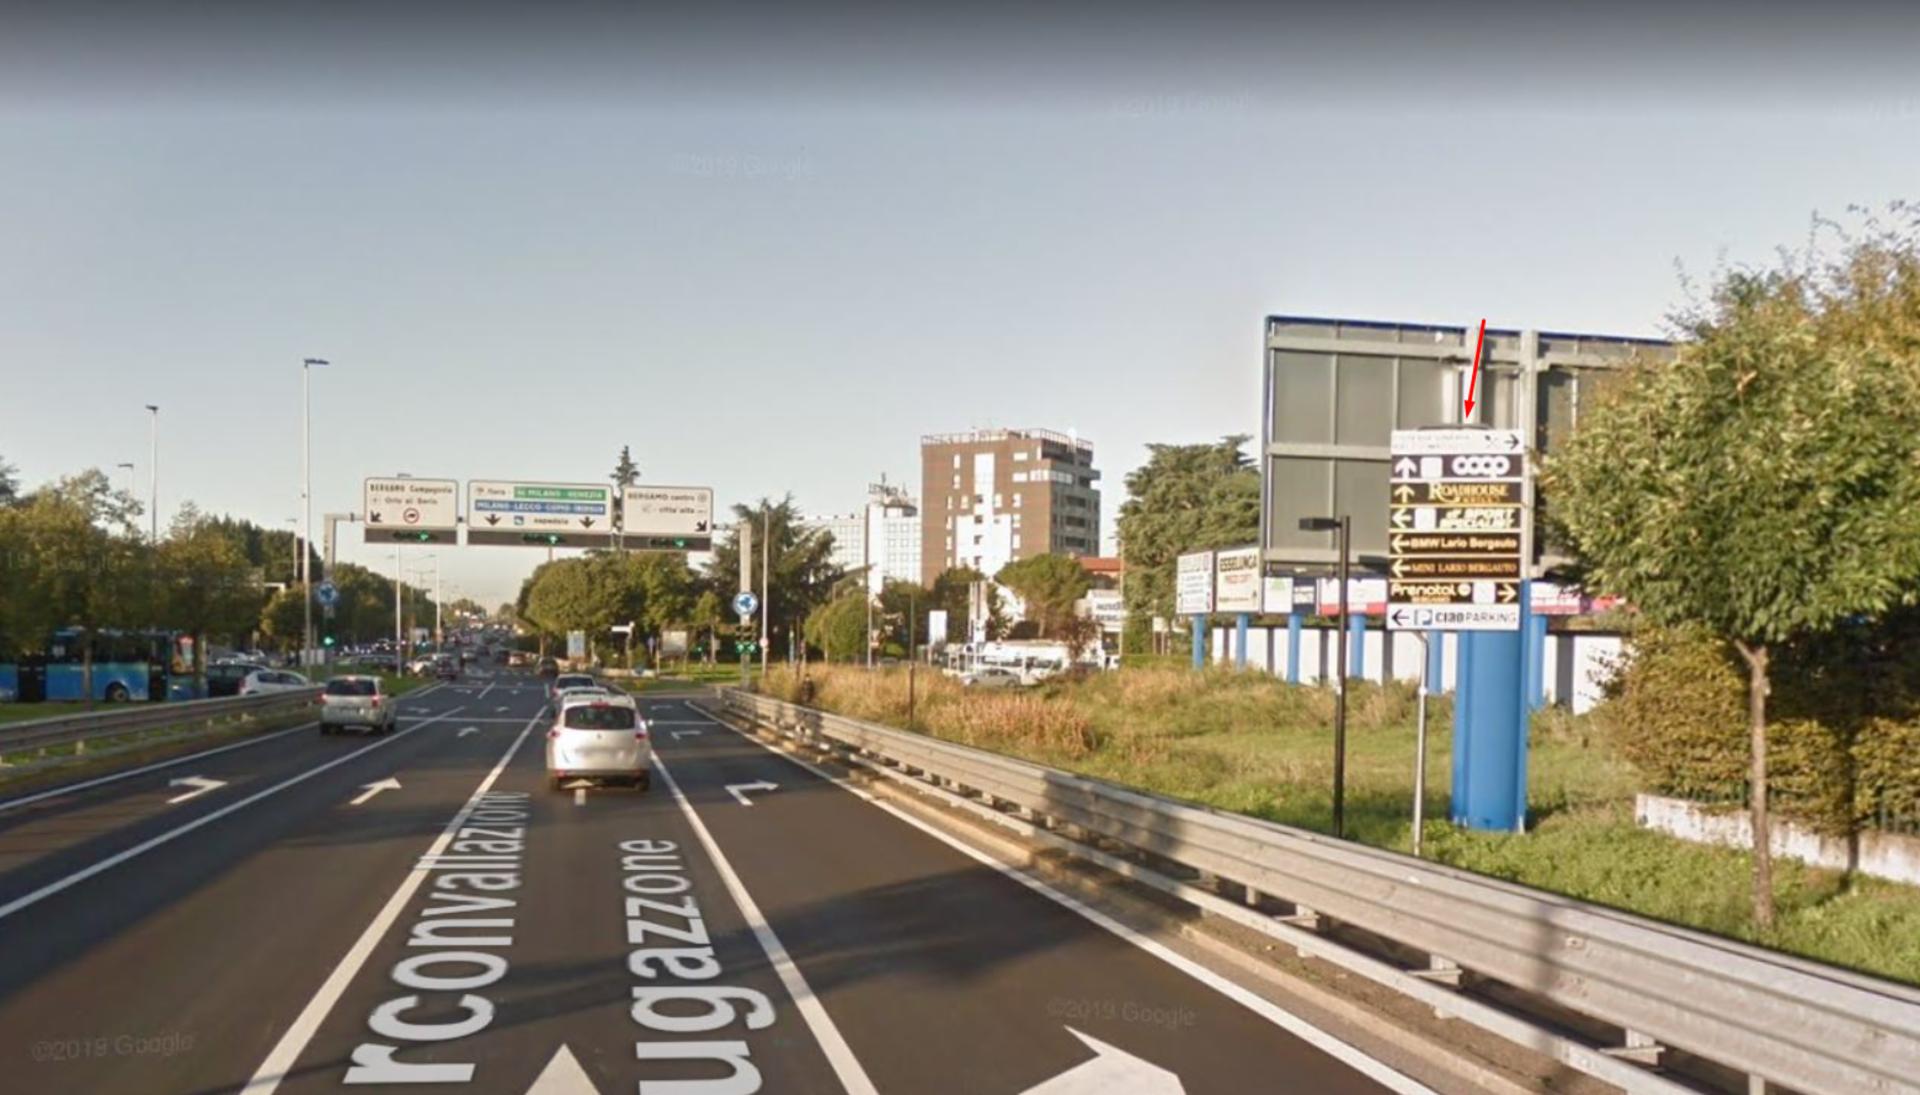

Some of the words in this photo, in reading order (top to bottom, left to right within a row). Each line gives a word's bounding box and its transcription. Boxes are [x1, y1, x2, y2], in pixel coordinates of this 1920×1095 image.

[1410, 537, 1439, 549] BMW
[1440, 538, 1468, 549] Lario
[1412, 563, 1436, 573] MINI
[1438, 563, 1467, 573] LARIO
